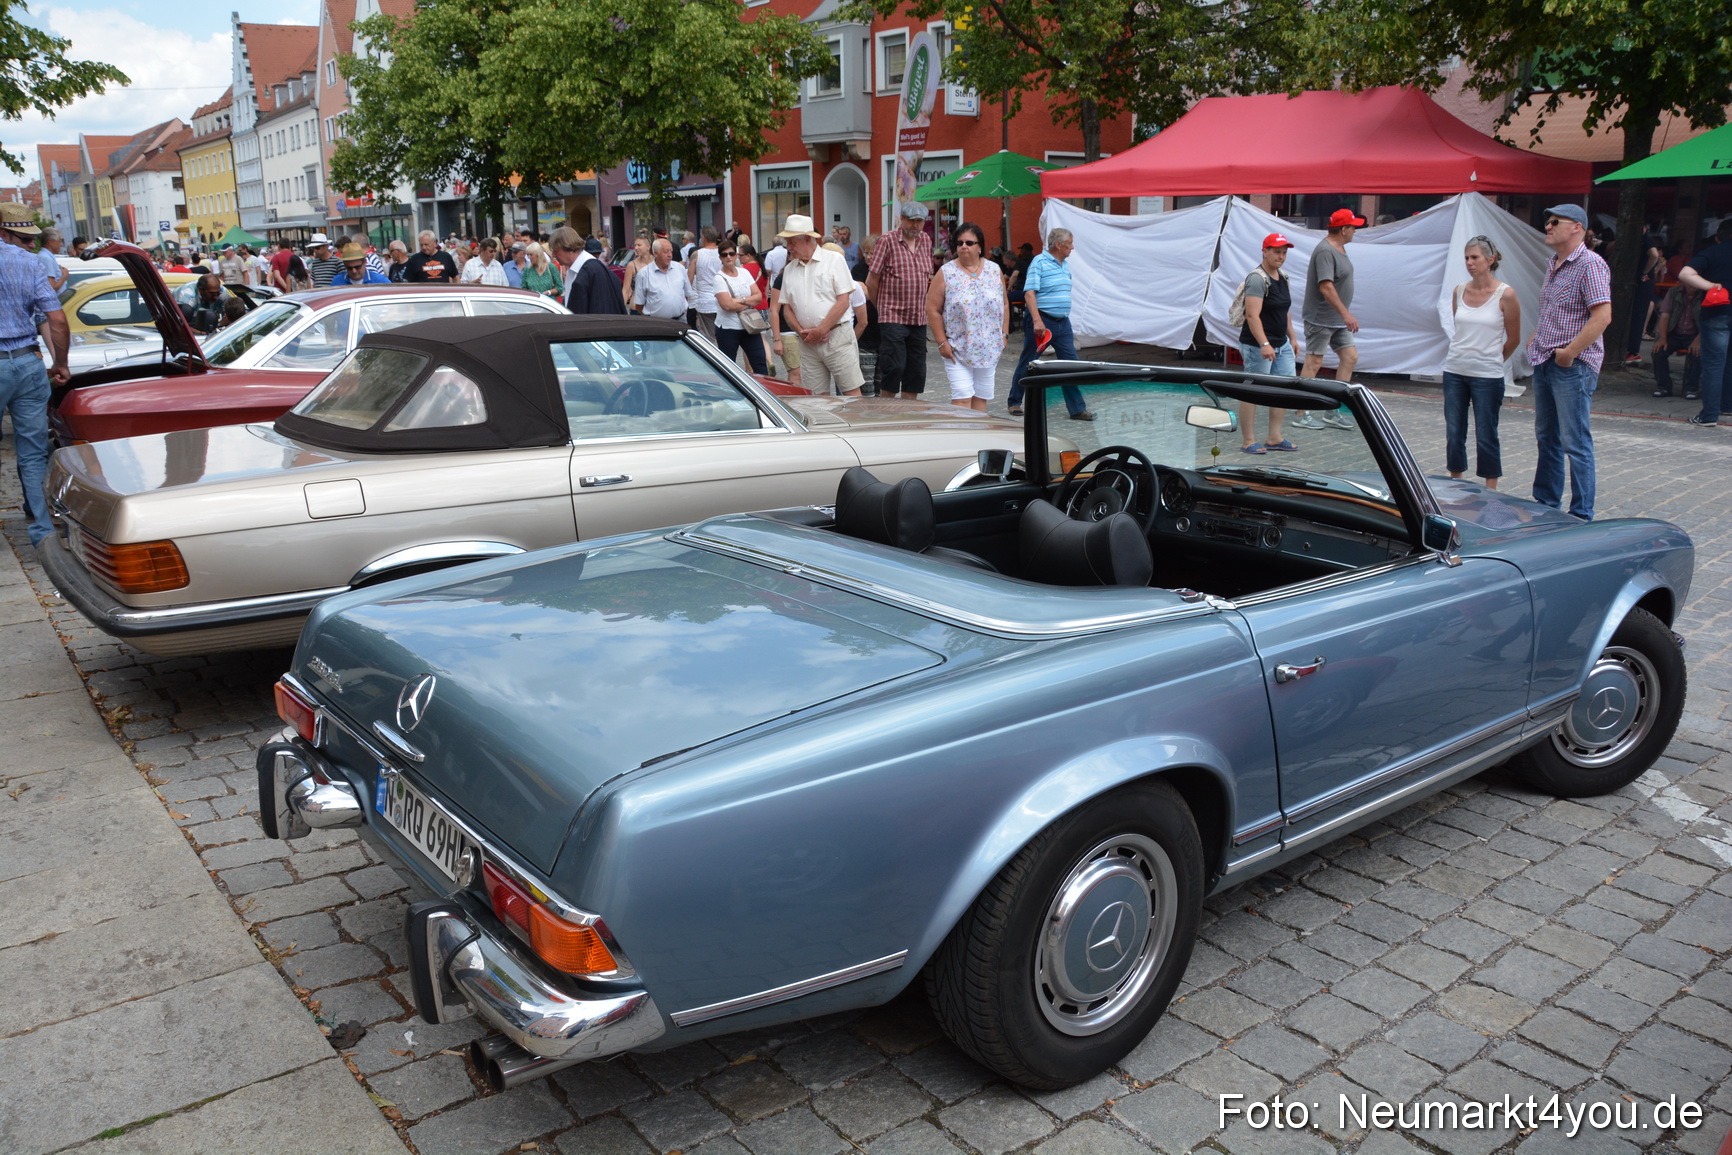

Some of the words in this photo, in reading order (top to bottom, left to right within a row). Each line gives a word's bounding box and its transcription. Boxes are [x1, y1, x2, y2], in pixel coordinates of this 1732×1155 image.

[908, 55, 925, 112] Bögerl
[385, 777, 395, 817] N
[403, 789, 424, 843] RQ
[426, 811, 458, 875] 69H
